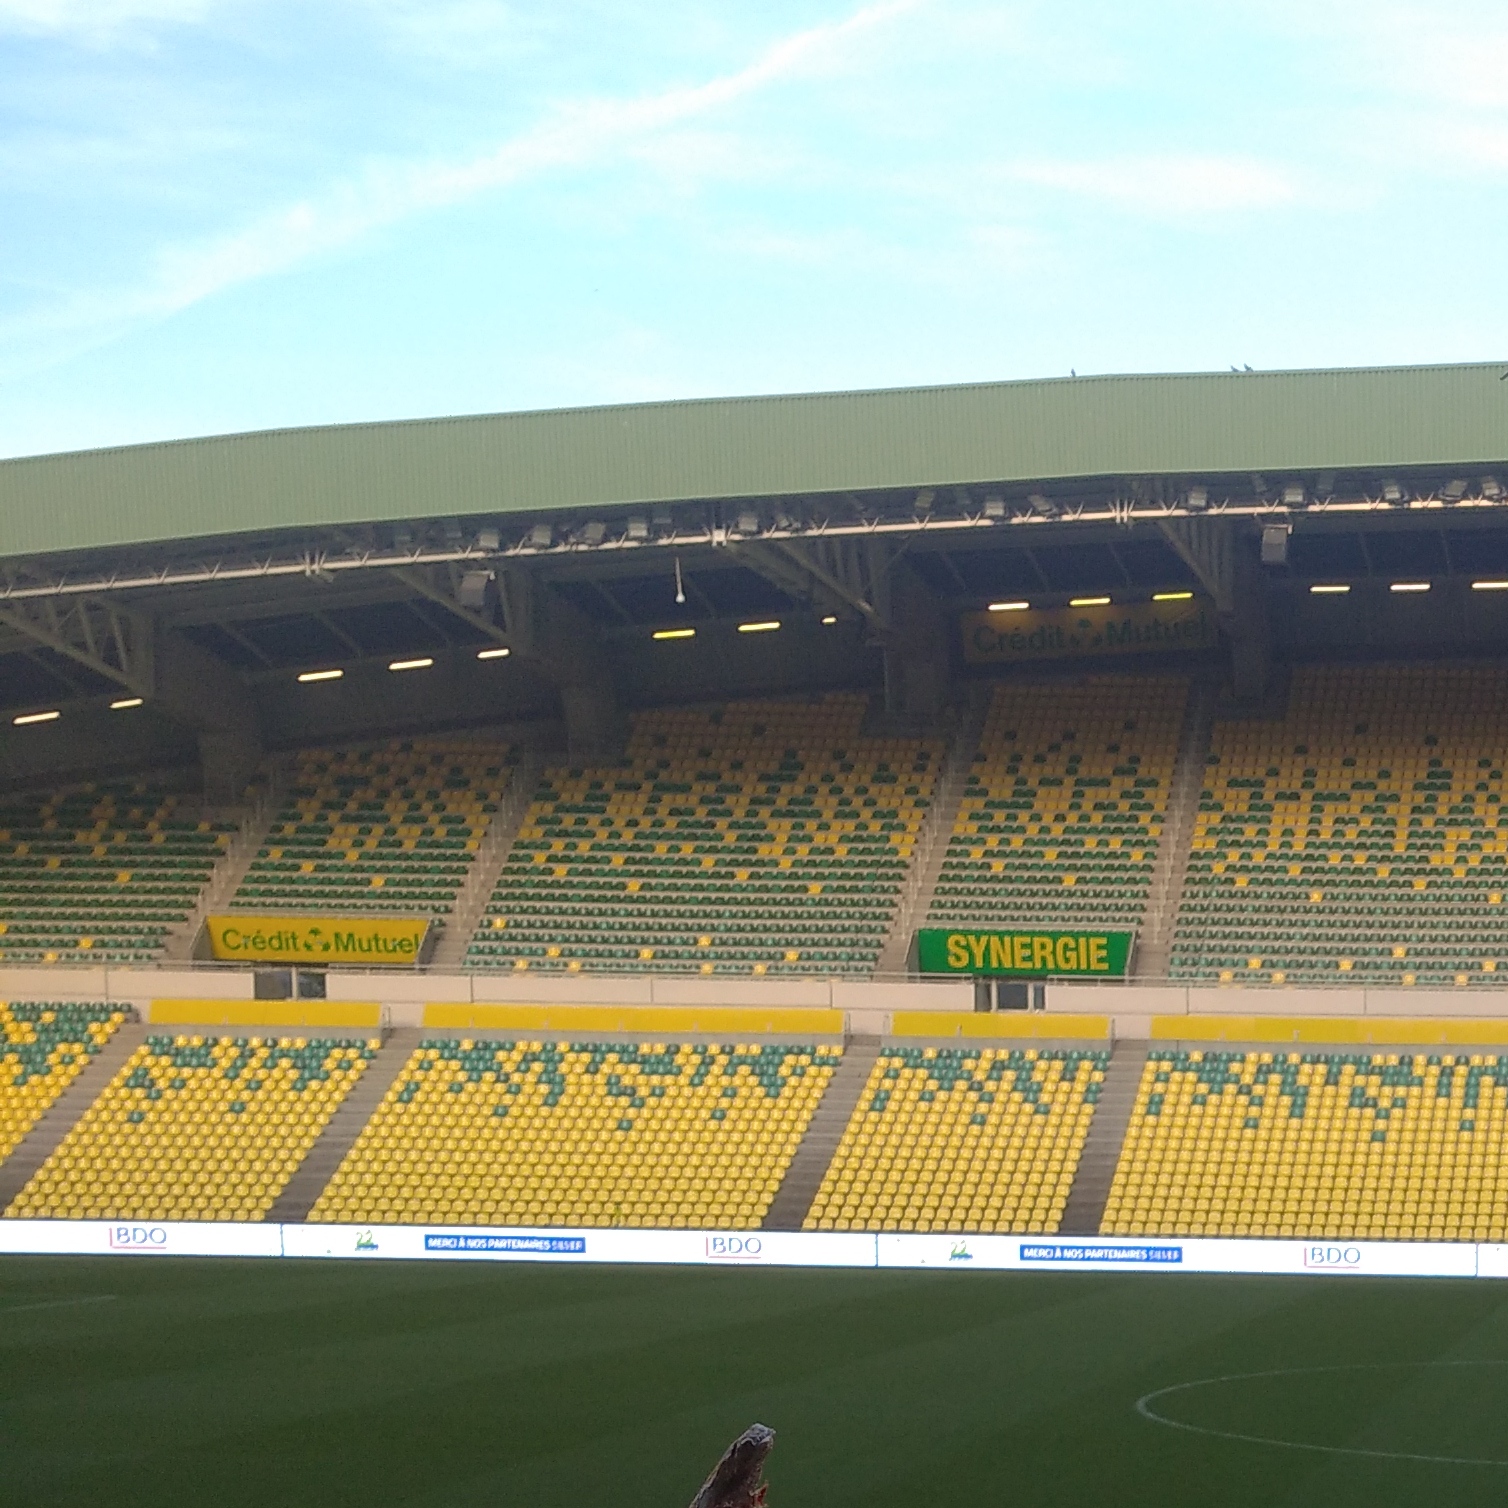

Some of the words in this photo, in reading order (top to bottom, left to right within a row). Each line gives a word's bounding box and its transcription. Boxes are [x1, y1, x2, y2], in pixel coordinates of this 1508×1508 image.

[973, 623, 1065, 654] Crédit
[1107, 610, 1206, 647] Mutuel
[222, 929, 299, 952] Crédit
[334, 931, 419, 954] Mutuel
[946, 934, 1109, 971] SYNERGIE
[117, 1227, 167, 1244] BDO
[428, 1238, 457, 1248] MERCI
[466, 1238, 487, 1249] NOS
[488, 1239, 551, 1250] PARTENAIRES
[713, 1237, 762, 1254] BDO
[1024, 1248, 1053, 1258] MERCI
[1063, 1248, 1083, 1259] NOS
[1084, 1249, 1147, 1259] PARTENAIRES
[1312, 1247, 1361, 1263] BDO
